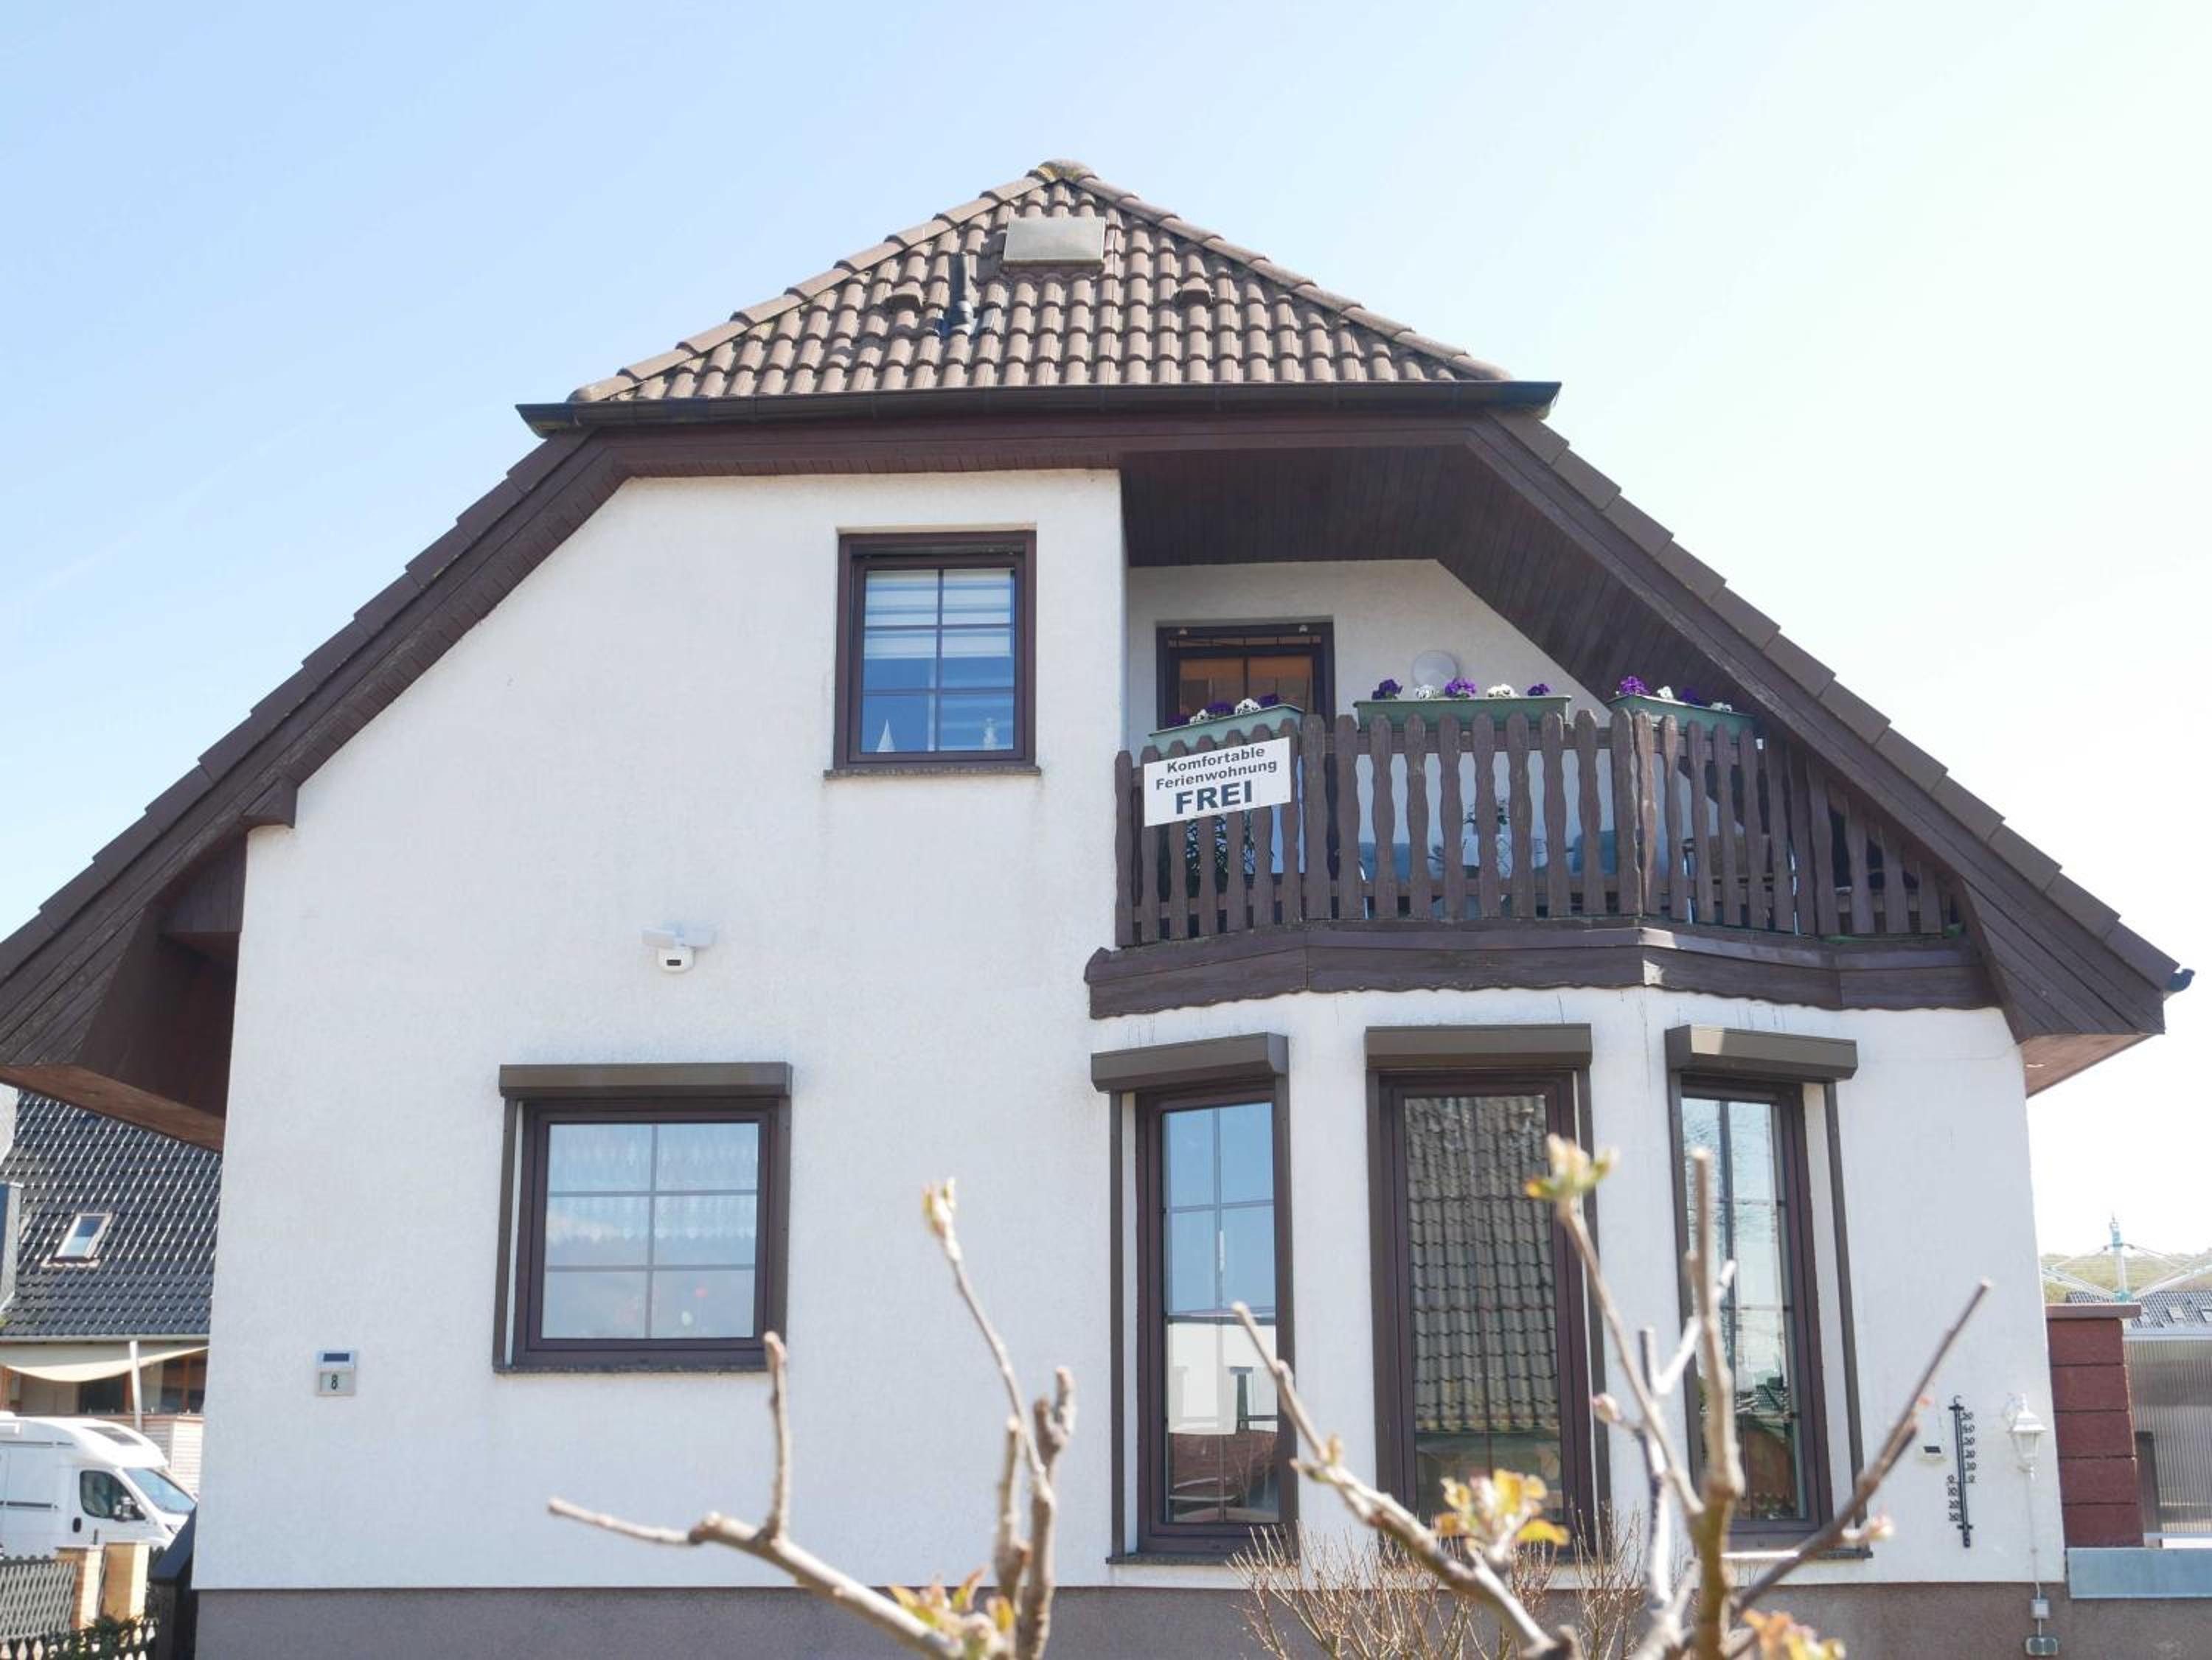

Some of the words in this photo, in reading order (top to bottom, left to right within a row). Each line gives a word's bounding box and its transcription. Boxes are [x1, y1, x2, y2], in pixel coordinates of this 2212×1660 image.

[1166, 747, 1265, 773] Komfortable
[1155, 760, 1277, 791] Ferienwohnung
[1175, 780, 1252, 815] FREI
[331, 1373, 338, 1390] 8
